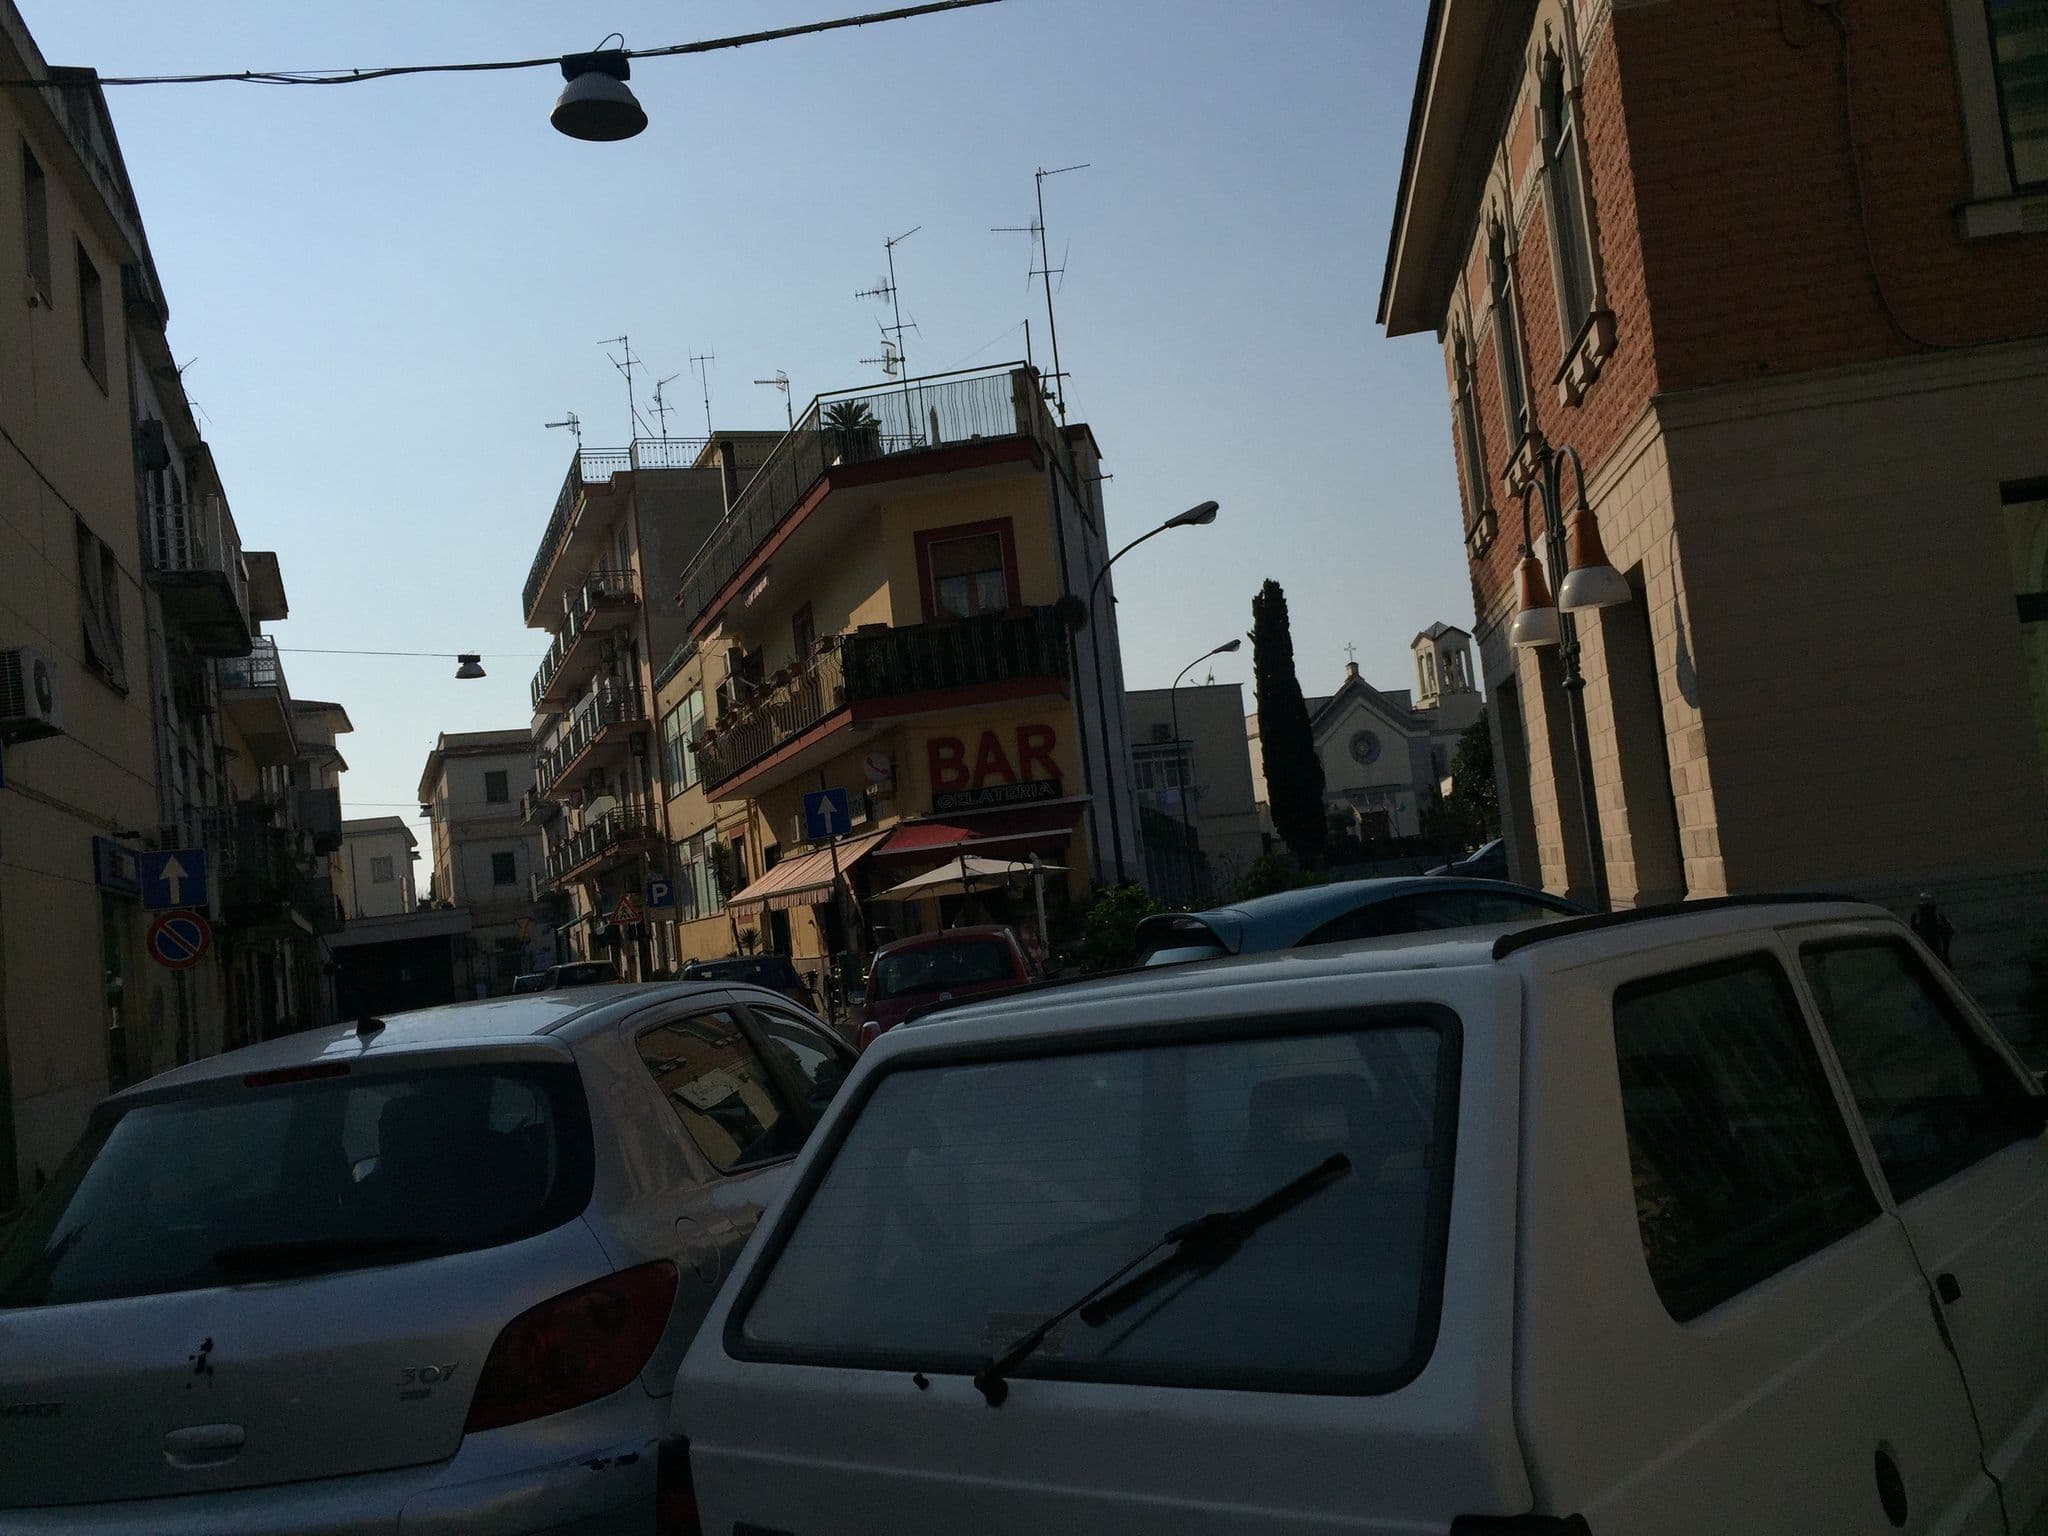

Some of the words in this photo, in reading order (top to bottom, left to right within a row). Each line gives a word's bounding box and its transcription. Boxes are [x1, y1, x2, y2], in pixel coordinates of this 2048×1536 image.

[927, 724, 1064, 794] BAR
[936, 780, 1055, 810] GELATERIA
[652, 883, 669, 905] P
[395, 1361, 459, 1387] 307
